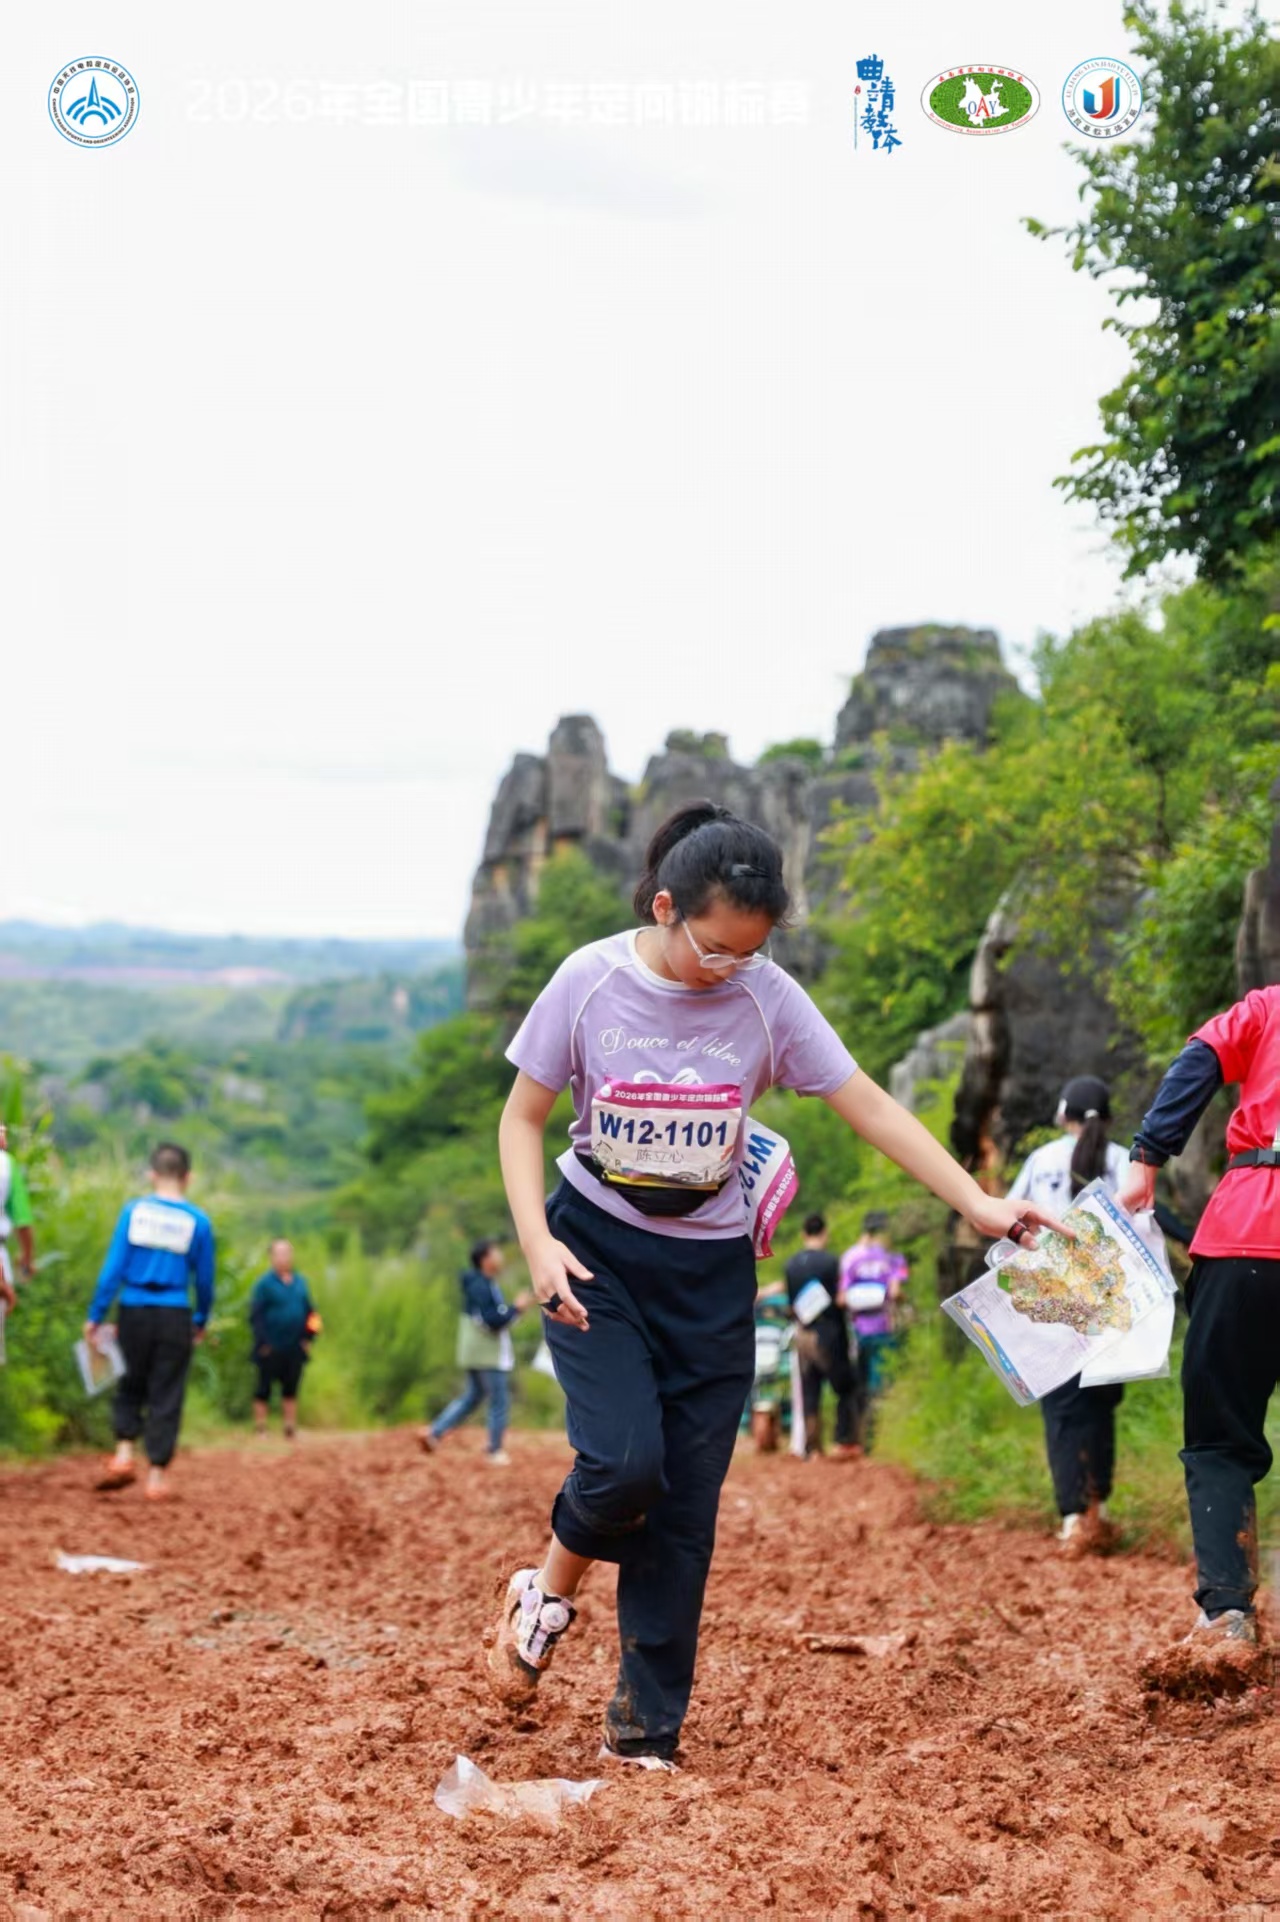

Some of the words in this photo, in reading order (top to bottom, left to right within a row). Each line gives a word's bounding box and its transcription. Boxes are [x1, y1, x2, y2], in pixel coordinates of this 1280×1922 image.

[599, 1026, 669, 1056] Douce
[676, 1036, 699, 1050] et
[599, 1110, 727, 1147] W12-1101
